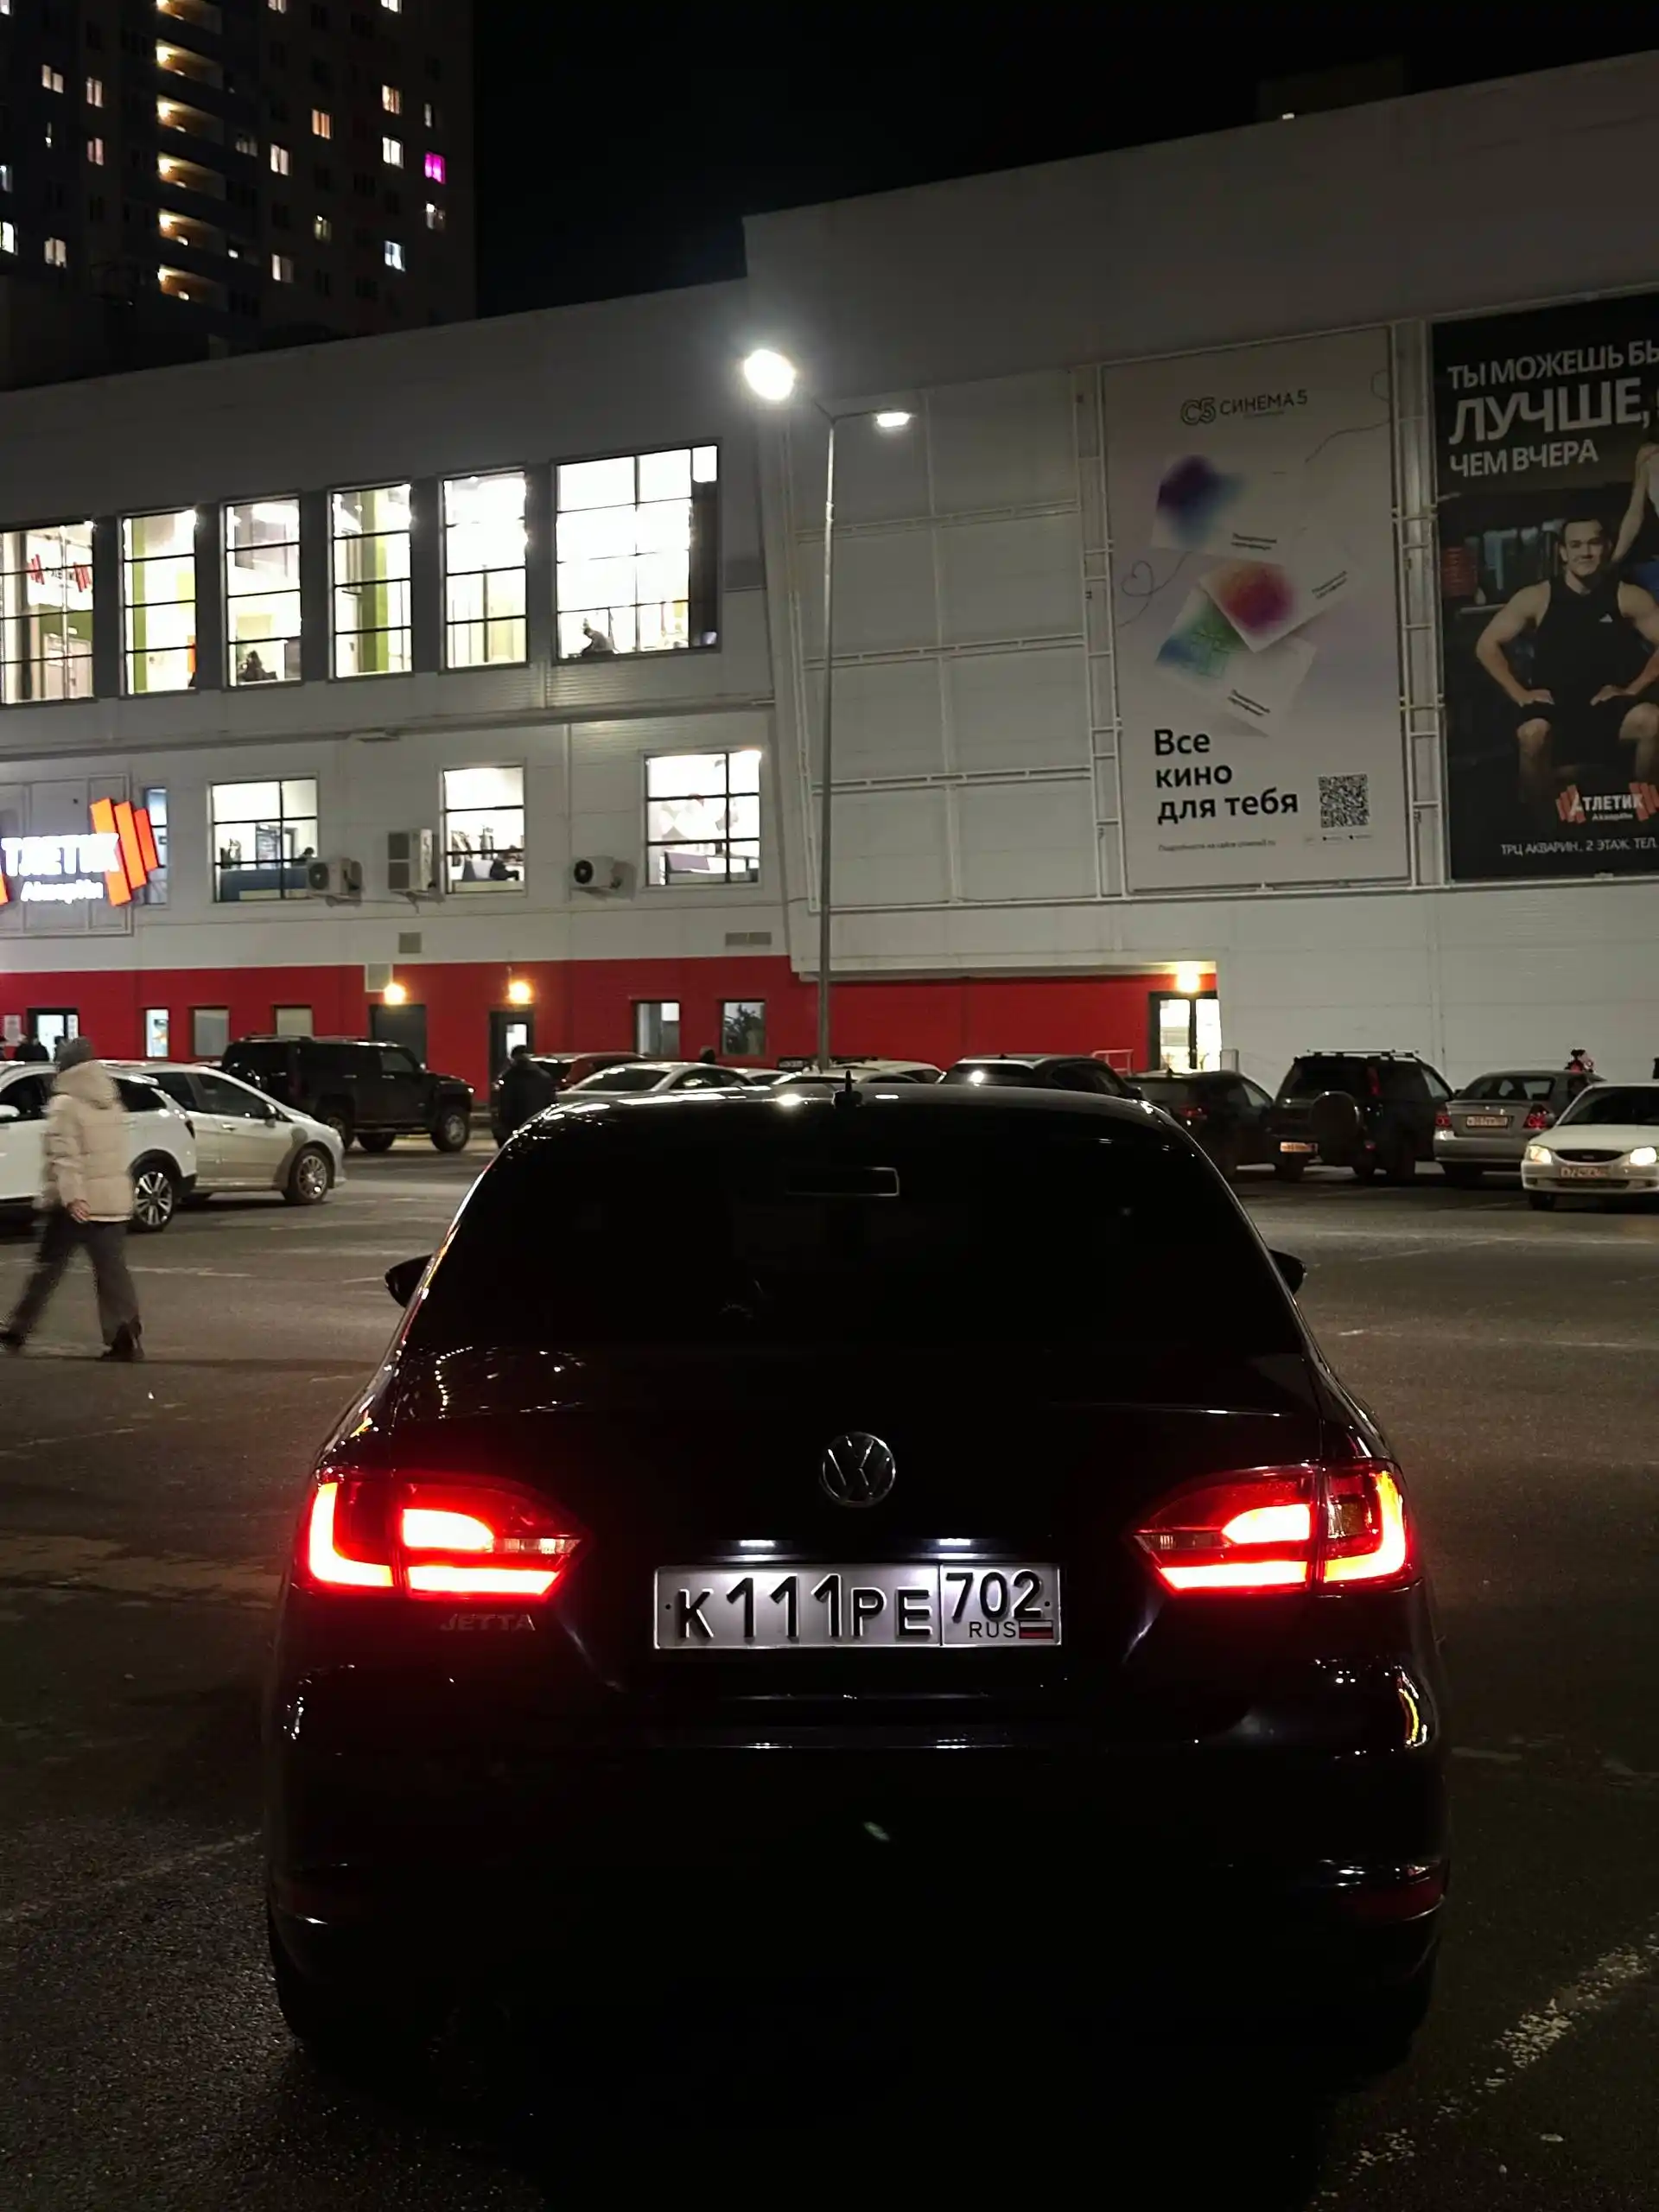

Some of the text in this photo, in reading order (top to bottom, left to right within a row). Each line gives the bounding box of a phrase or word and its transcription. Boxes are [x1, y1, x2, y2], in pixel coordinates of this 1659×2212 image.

[1447, 362, 1484, 390] ТЫ
[1491, 345, 1624, 385] МОЖЕШЬ
[1448, 377, 1651, 446] ЛУЧШЕ,
[1449, 438, 1600, 478] ЧЕМ ВЧЕРА
[1154, 728, 1210, 756] Все
[1155, 764, 1233, 789] кино
[1157, 786, 1299, 825] для тебя
[1500, 843, 1524, 856] ТРЦ
[1586, 839, 1595, 853] 2
[945, 1568, 1042, 1623] 702
[440, 1613, 536, 1631] JETTA
[968, 1621, 1017, 1639] RUS
